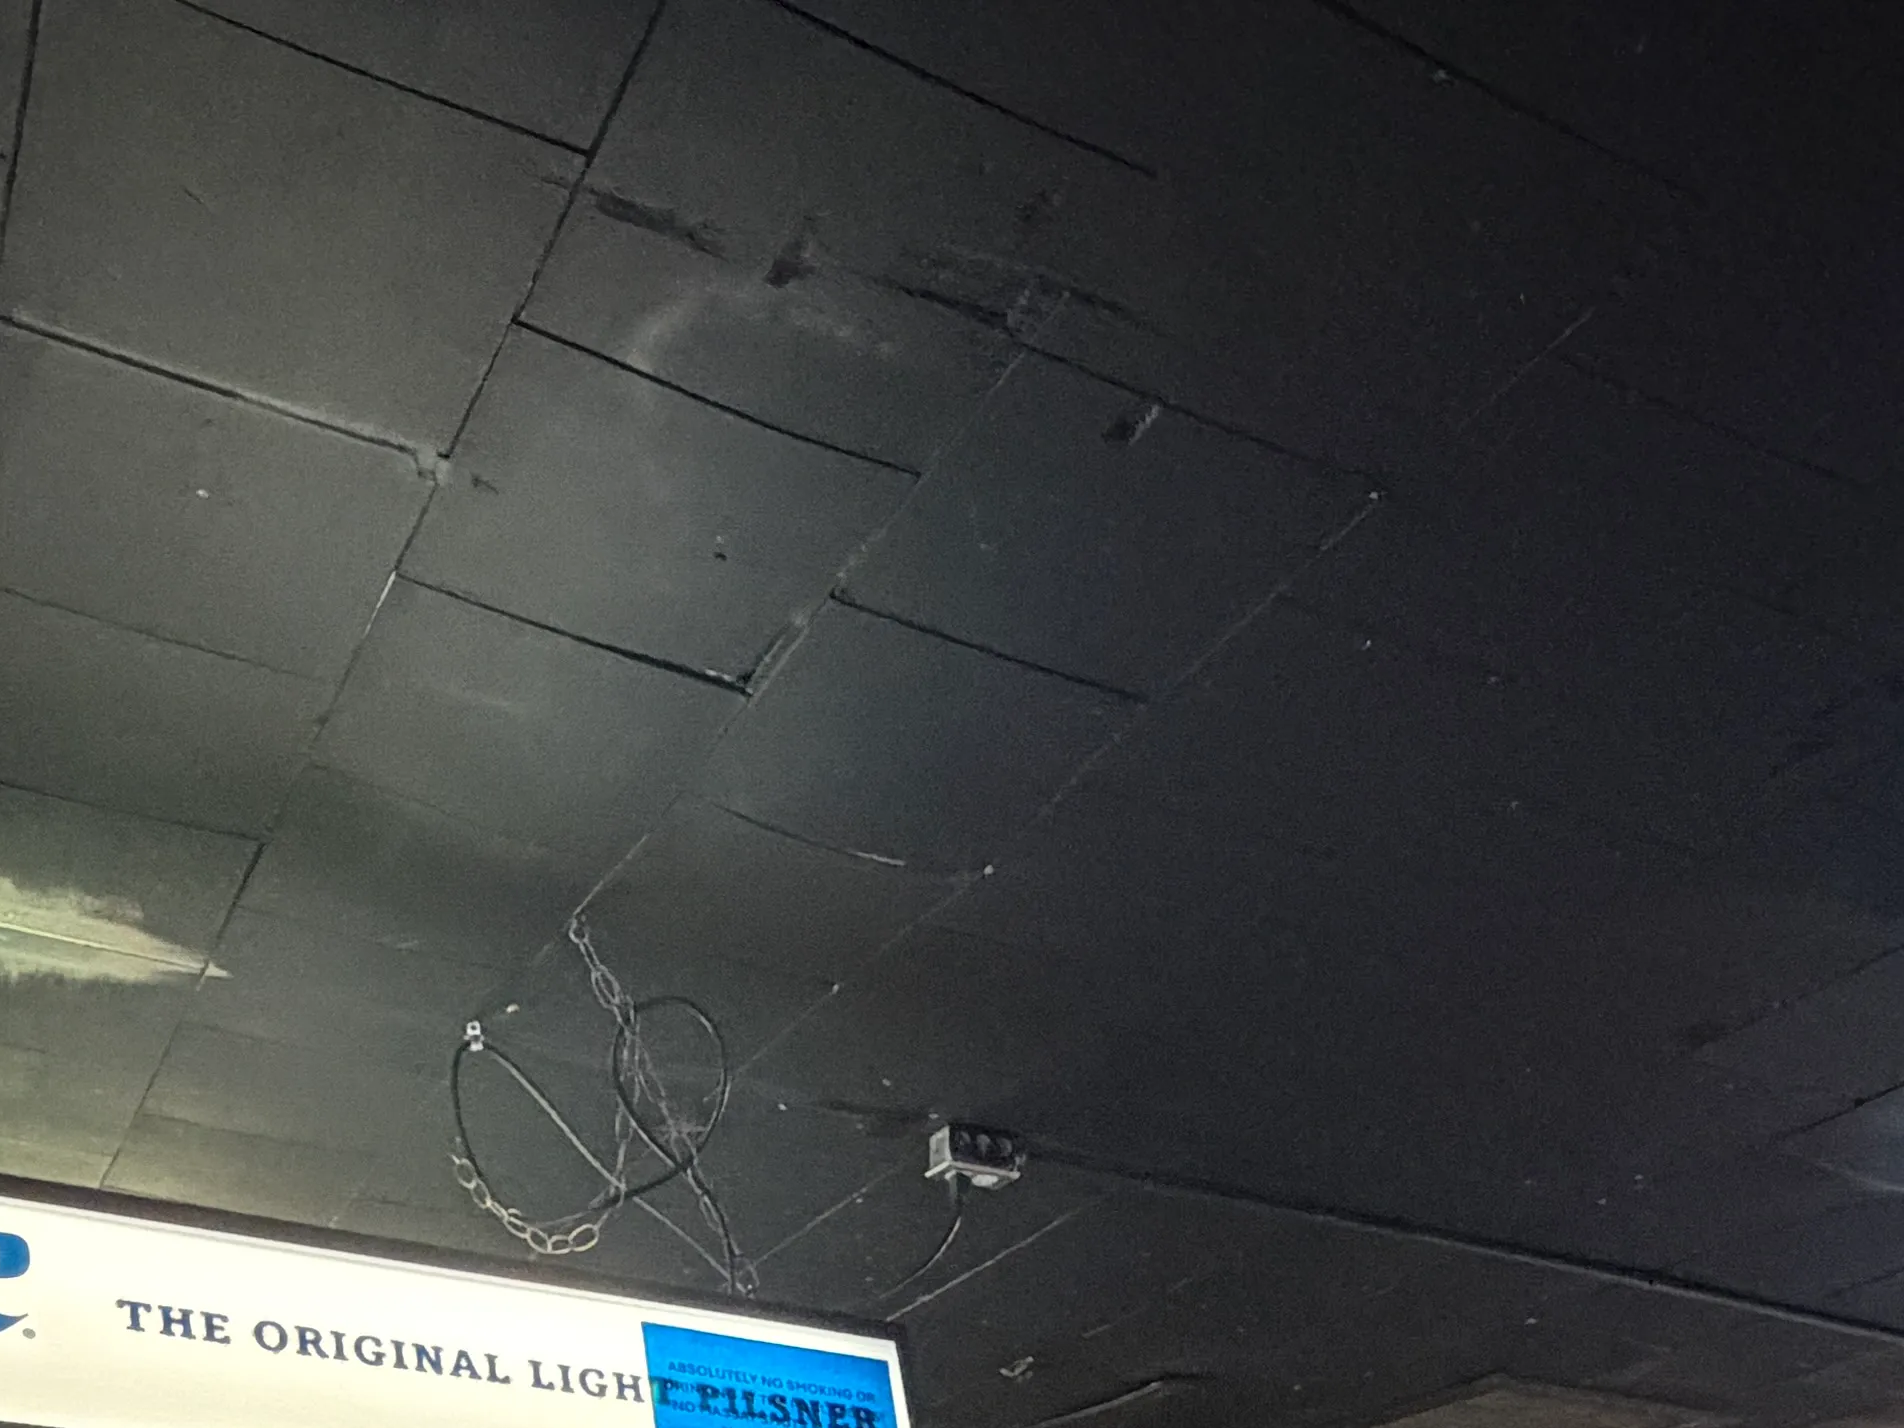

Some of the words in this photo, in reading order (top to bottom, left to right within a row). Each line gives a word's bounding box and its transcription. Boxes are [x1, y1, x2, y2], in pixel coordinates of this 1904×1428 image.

[115, 1298, 232, 1345] THE
[253, 1319, 511, 1386] ORIGINAL
[528, 1358, 673, 1406] LIGHT
[667, 1360, 758, 1385] ABSOLUTELY
[761, 1376, 785, 1389] NO
[786, 1379, 853, 1401] SMOKING
